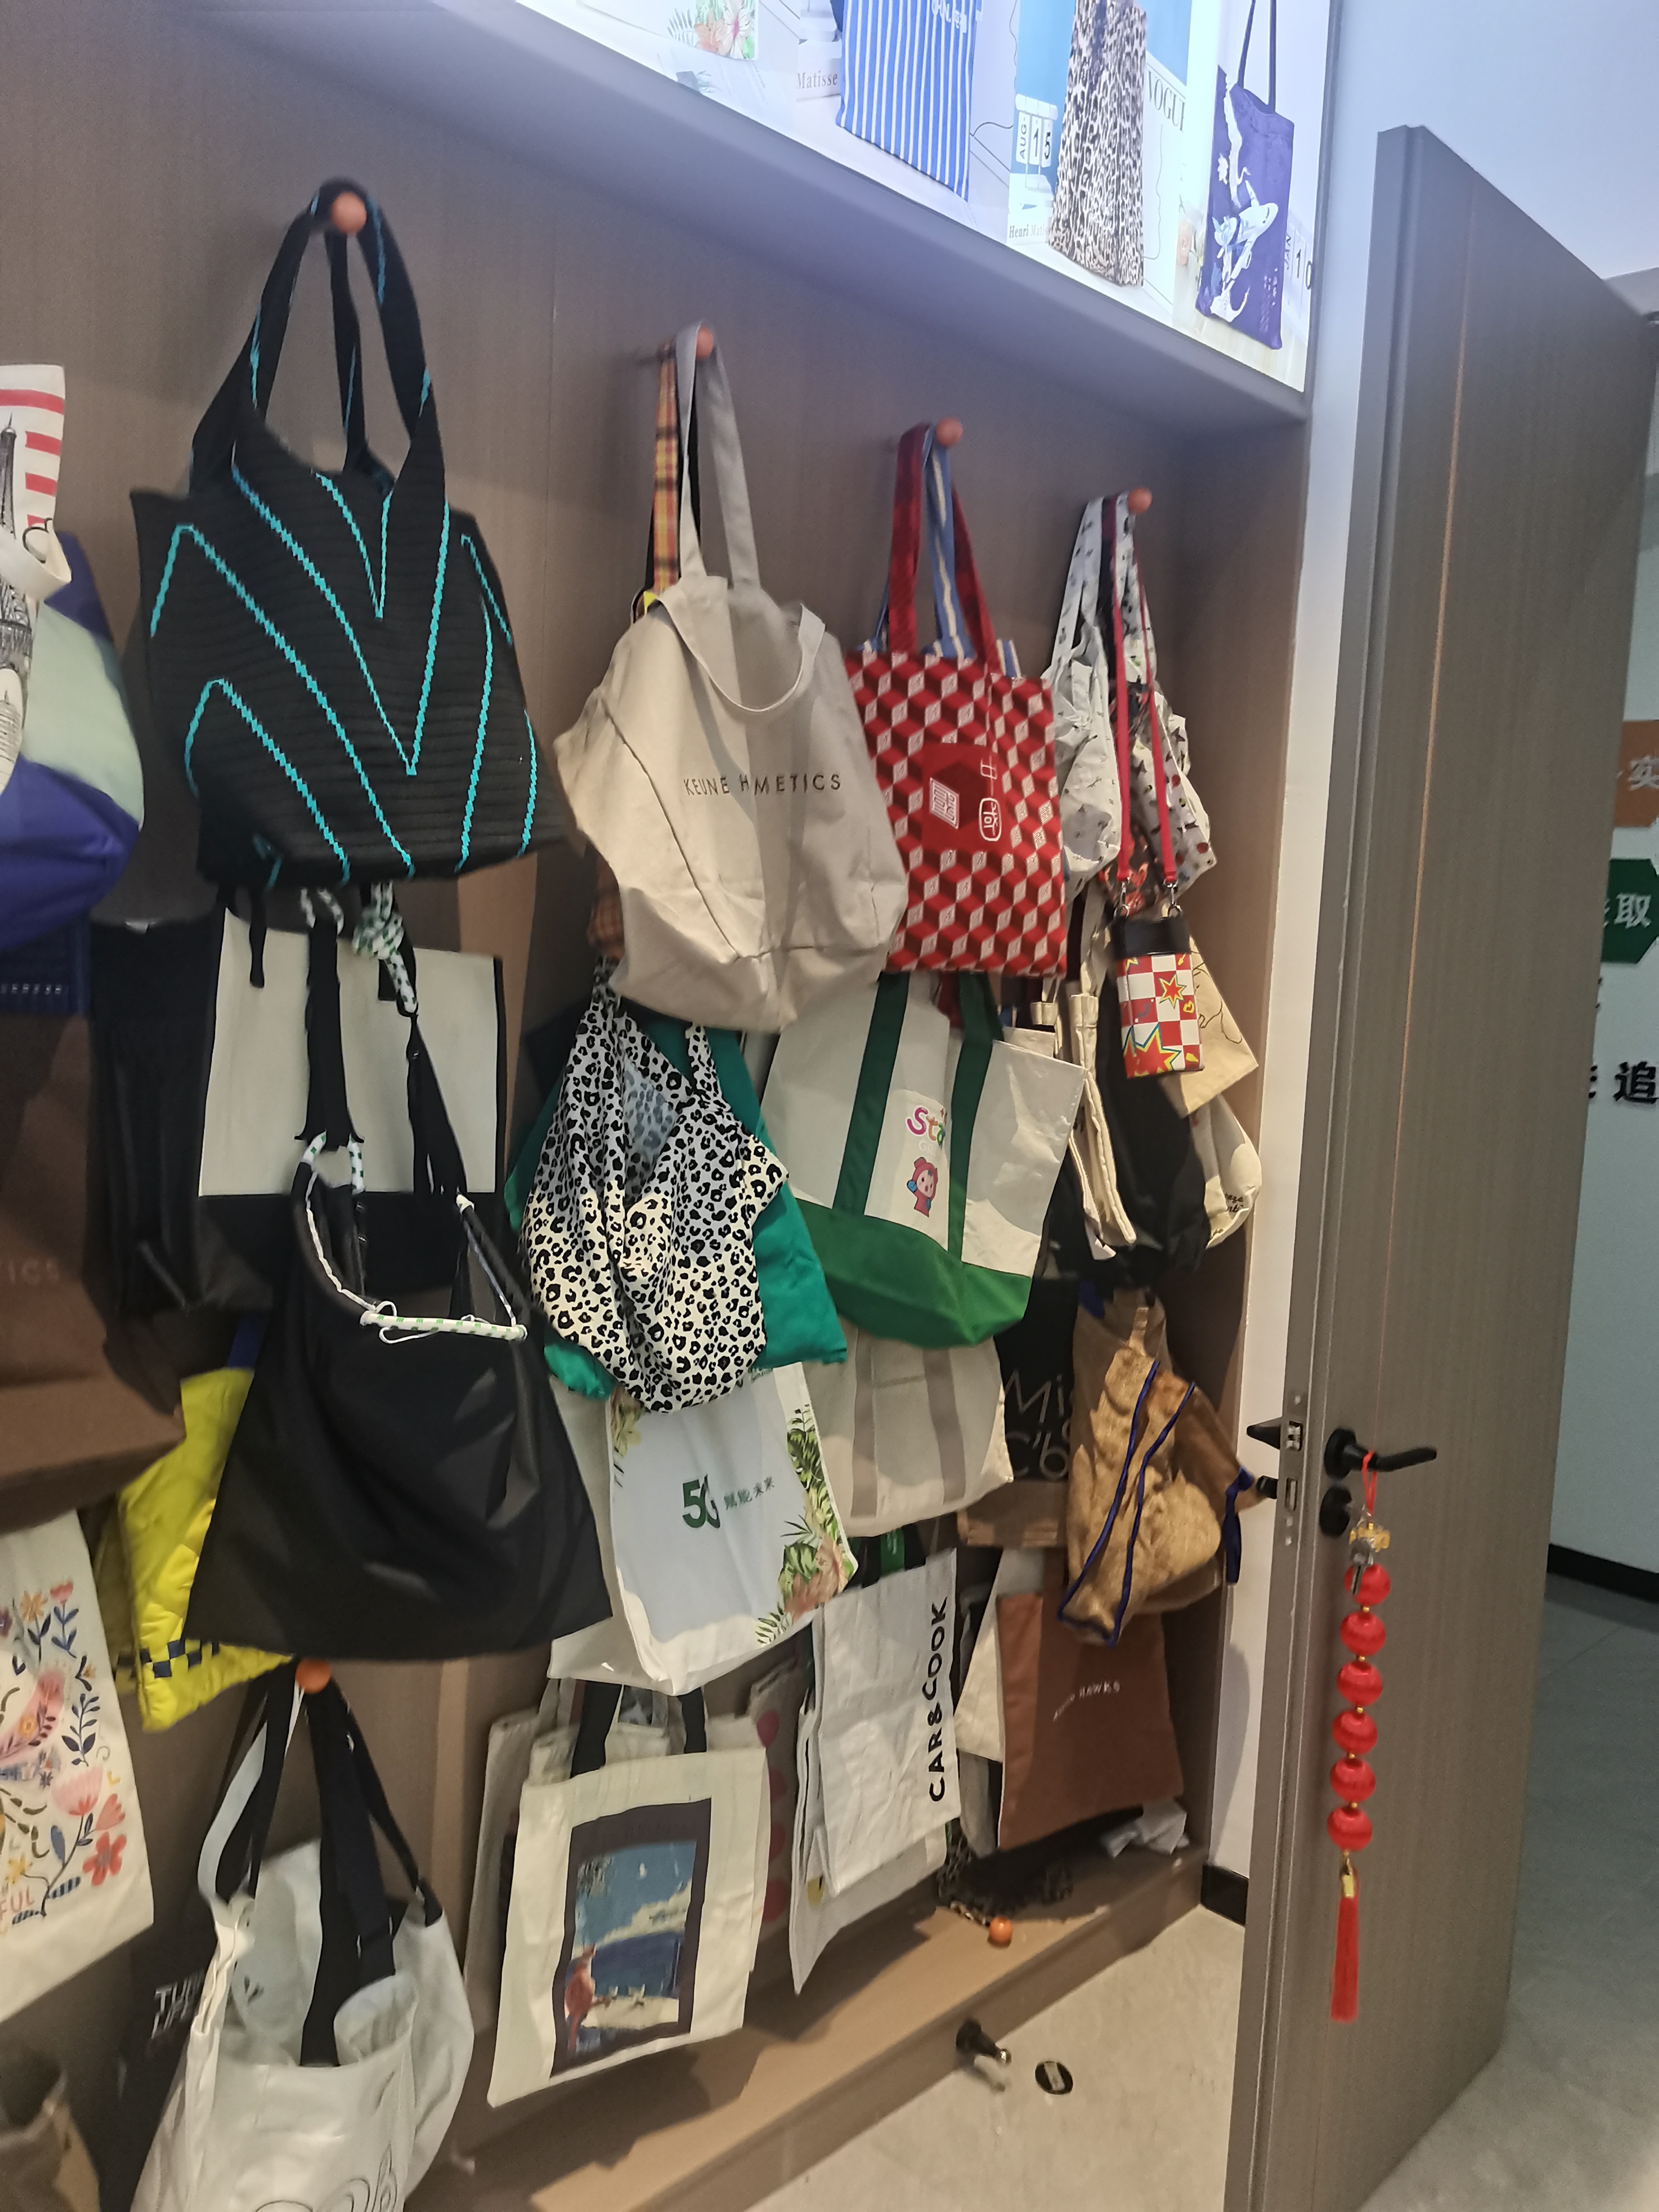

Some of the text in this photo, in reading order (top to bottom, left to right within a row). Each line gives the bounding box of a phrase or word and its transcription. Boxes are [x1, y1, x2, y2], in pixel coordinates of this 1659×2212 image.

[797, 70, 837, 89] Matisse
[1009, 224, 1029, 239] Henri
[684, 773, 730, 795] KEUNE
